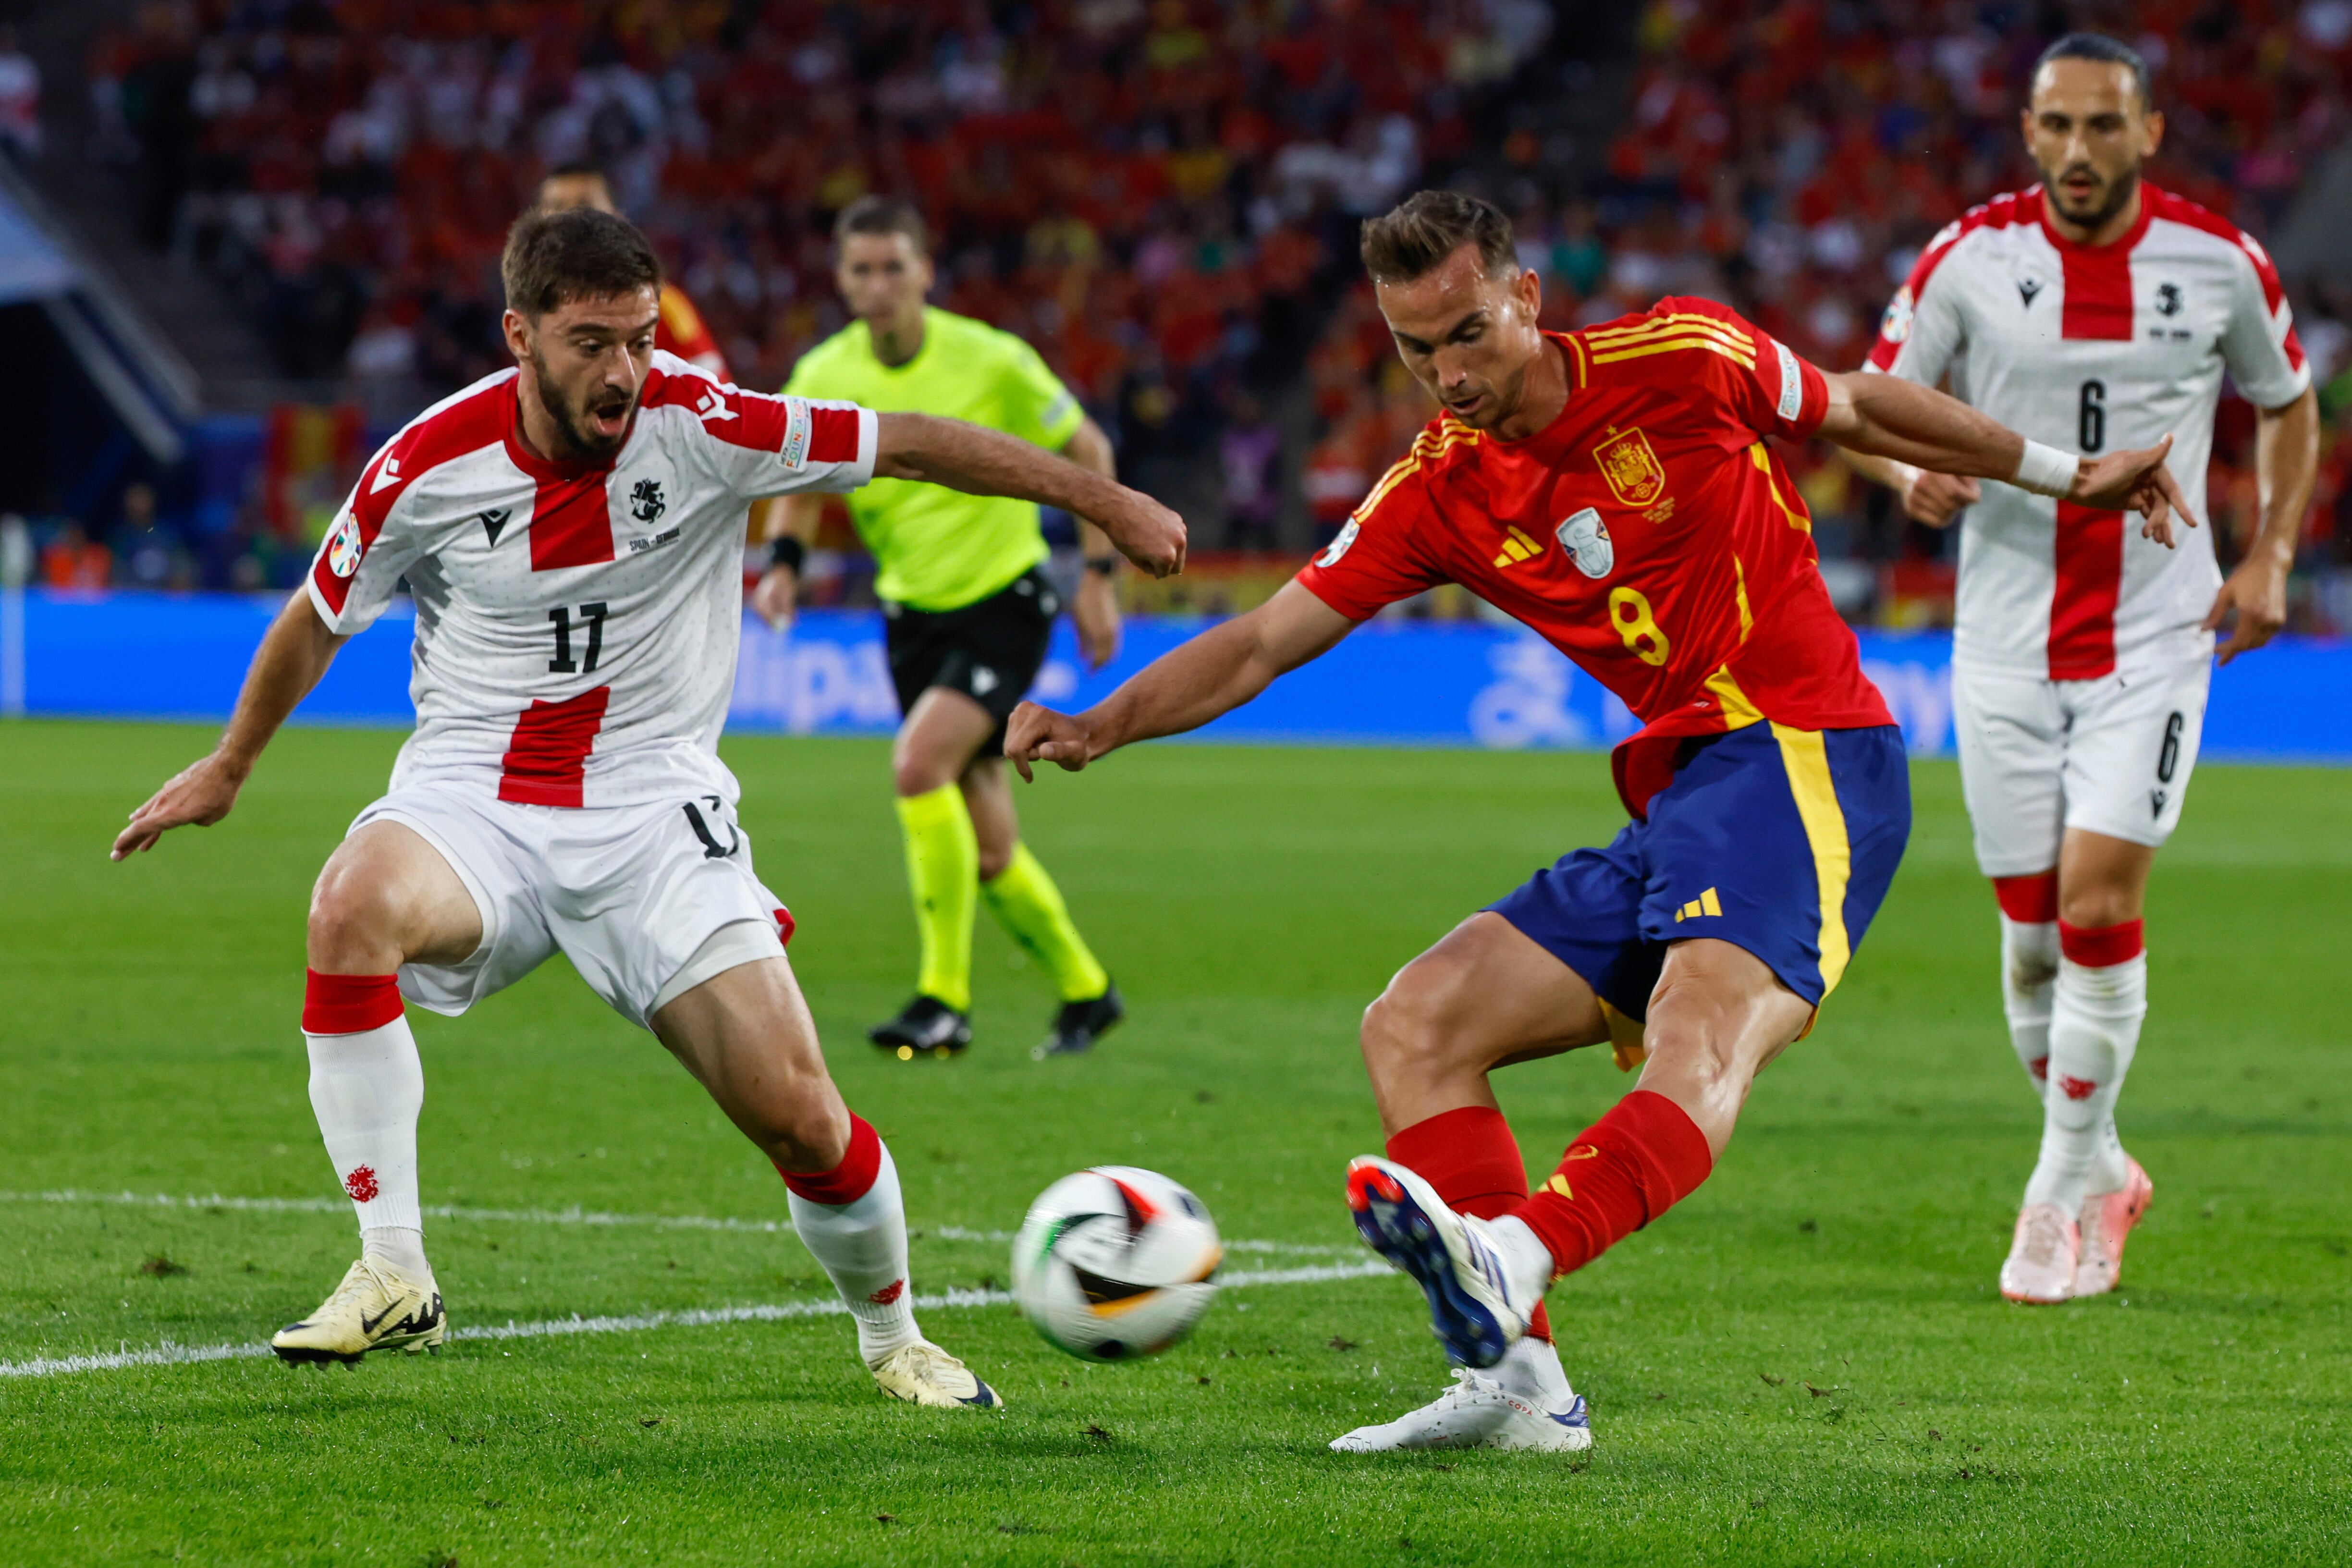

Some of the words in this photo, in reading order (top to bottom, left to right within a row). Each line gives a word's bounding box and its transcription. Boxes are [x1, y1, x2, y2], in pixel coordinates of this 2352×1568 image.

[2080, 379, 2105, 453] 6
[549, 602, 609, 673] 17
[1608, 586, 1670, 666] 8
[2158, 711, 2183, 783] 6
[1508, 1399, 1533, 1417] COPA
